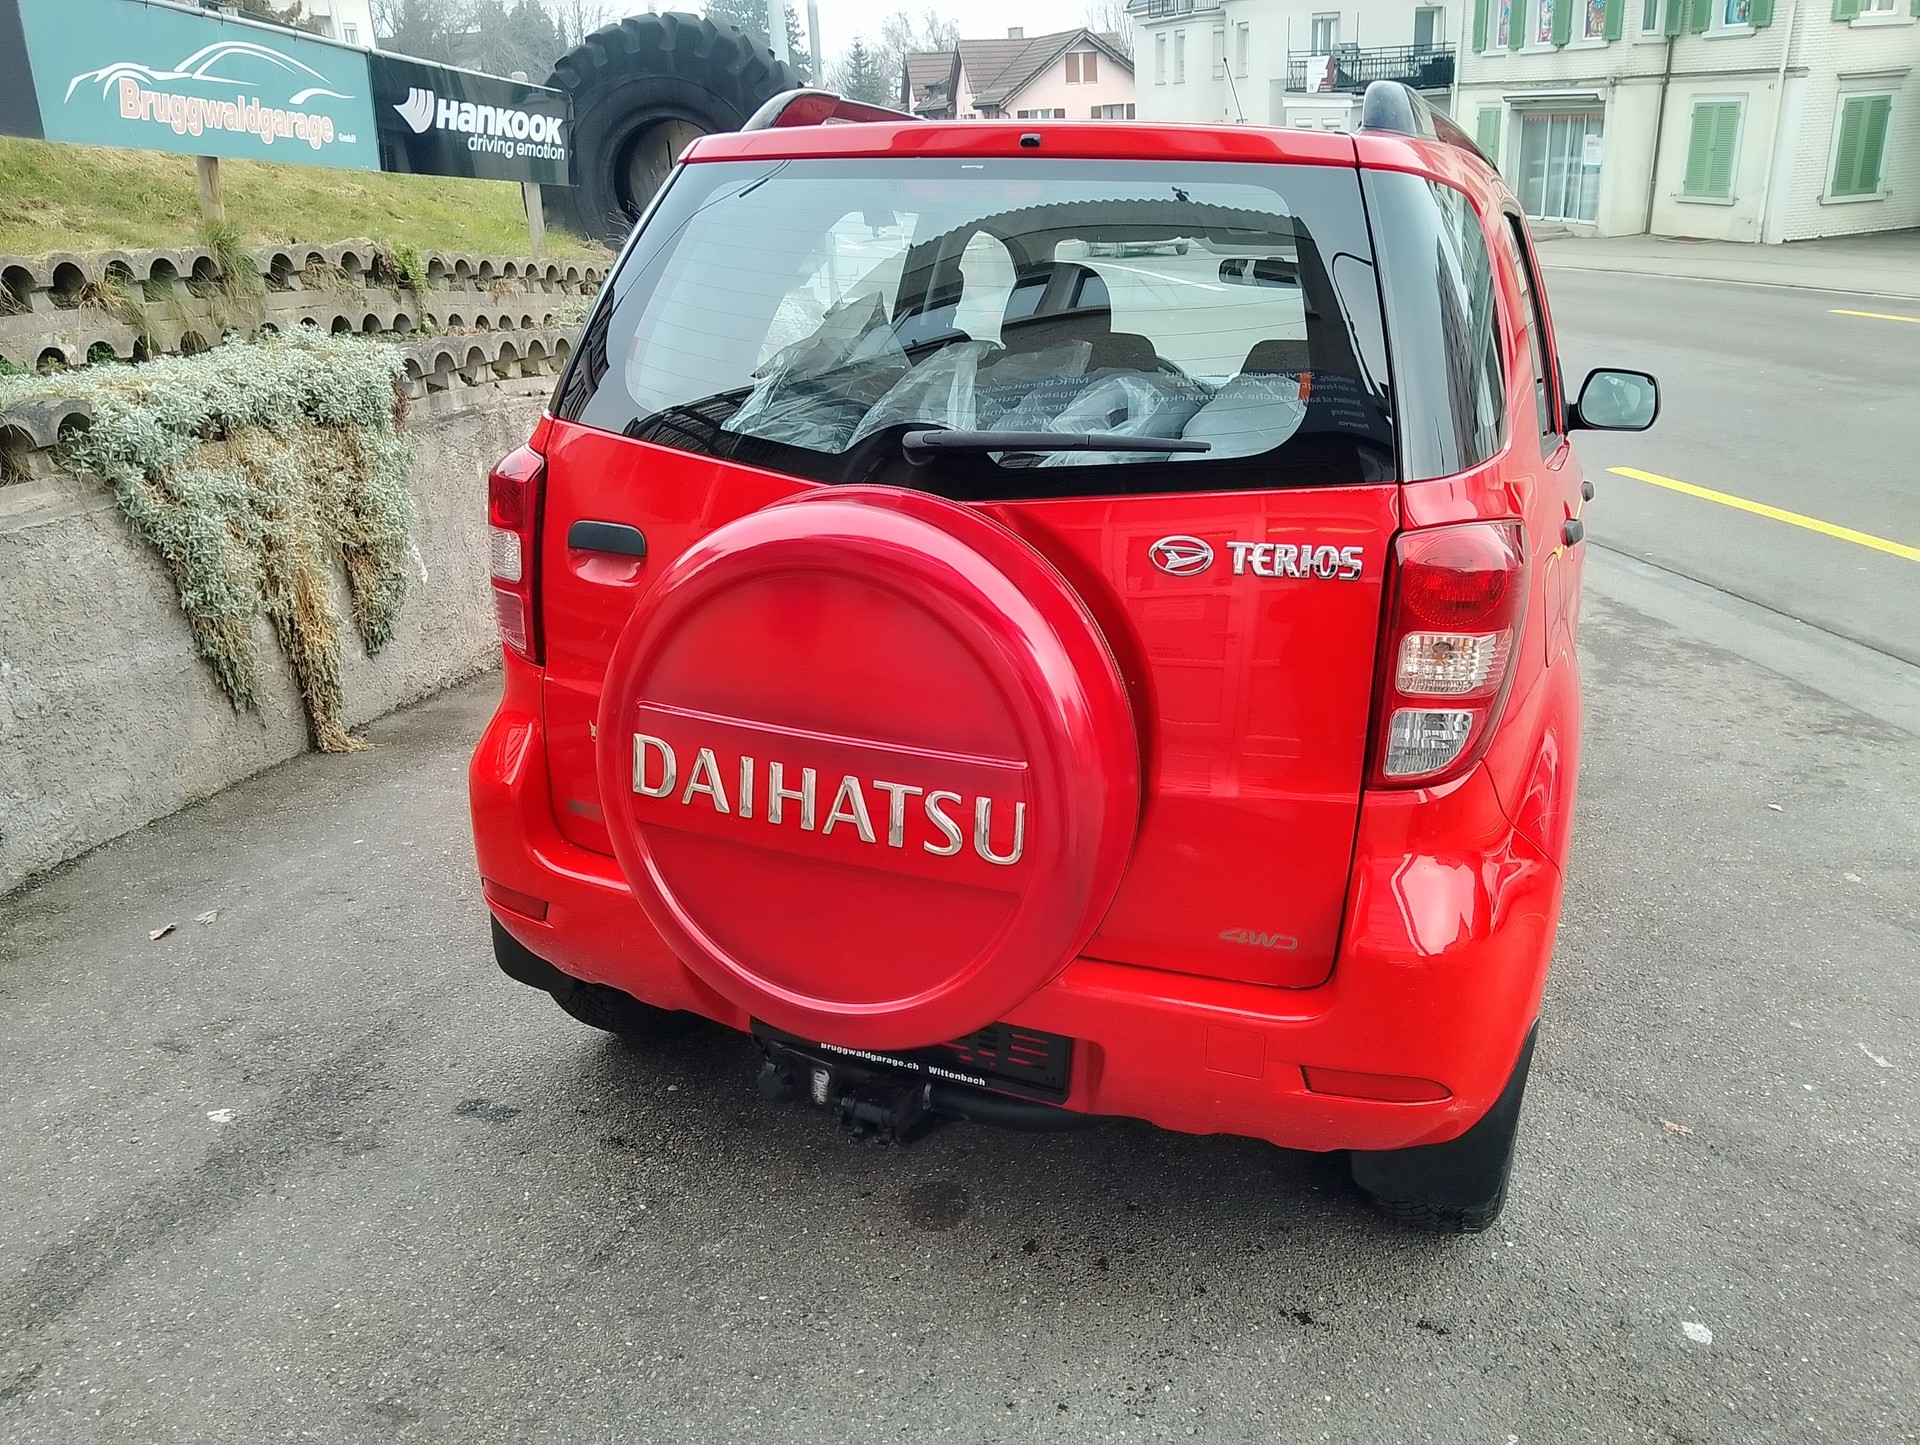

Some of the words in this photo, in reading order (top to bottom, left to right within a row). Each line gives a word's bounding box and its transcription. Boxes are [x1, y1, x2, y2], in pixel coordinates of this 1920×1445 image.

[118, 77, 334, 150] Bruggwaldgarage
[467, 133, 514, 159] driving
[516, 142, 565, 160] emotion
[1226, 541, 1364, 581] TERIOS
[631, 732, 1027, 866] DAIHATSU
[1219, 929, 1298, 950] 4WD
[928, 1065, 986, 1087] Wittenbach
